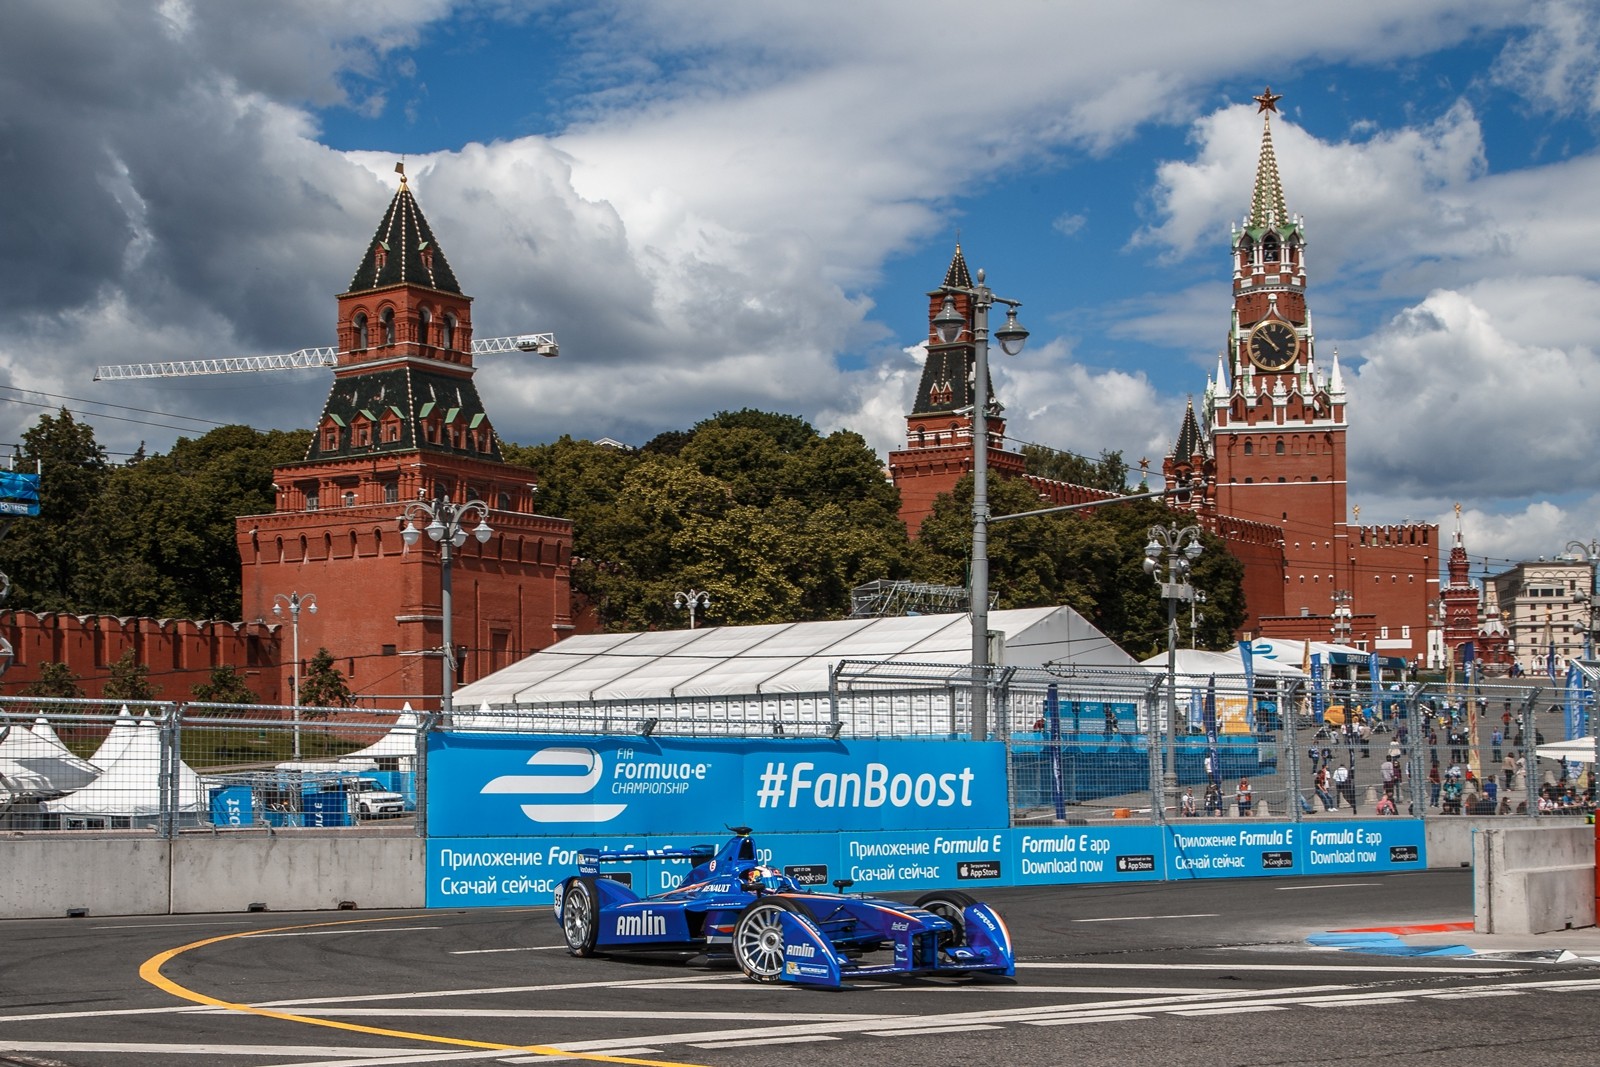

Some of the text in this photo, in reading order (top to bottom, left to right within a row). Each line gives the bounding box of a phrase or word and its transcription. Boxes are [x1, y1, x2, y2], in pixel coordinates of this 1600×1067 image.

[617, 748, 634, 760] FIA
[612, 782, 689, 794] CHAMPIONSHIP
[756, 762, 974, 809] #FanBoost
[1022, 835, 1110, 854] Formula E app
[1174, 829, 1293, 850] Приложение Formula E
[1310, 828, 1382, 846] Formula E app
[850, 835, 1002, 860] Приложение Formula E
[441, 849, 542, 870] Приложение
[1175, 854, 1245, 870] Скачай сейчас
[1310, 849, 1376, 864] Download now
[851, 864, 940, 882] Скачай сейчас
[970, 869, 982, 878] App
[1022, 858, 1103, 875] Download now
[1128, 862, 1138, 870] App
[441, 873, 554, 894] Скачай сейчас
[794, 873, 826, 883] Google play
[701, 884, 731, 892] RENAULT
[555, 894, 561, 907] 55
